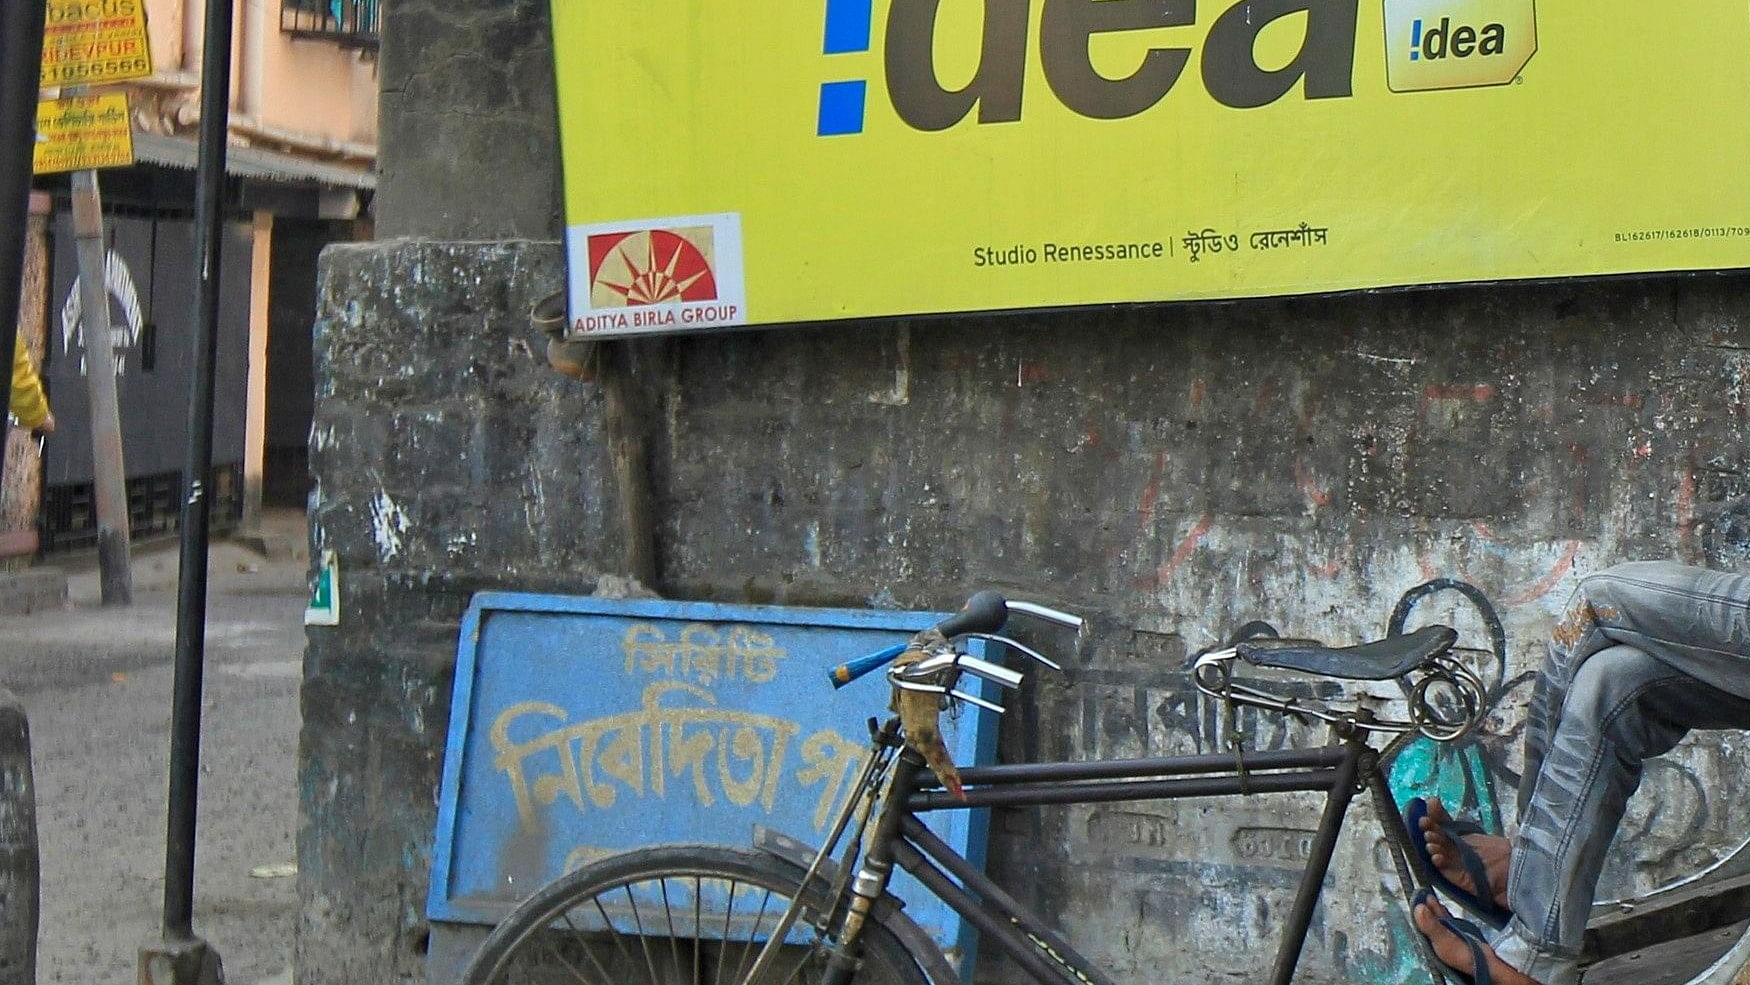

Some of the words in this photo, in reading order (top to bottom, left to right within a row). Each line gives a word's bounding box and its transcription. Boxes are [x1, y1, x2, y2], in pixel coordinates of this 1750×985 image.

[973, 245, 1037, 268] Studio
[1044, 240, 1164, 263] Renessance
[574, 313, 629, 333] ADITYA
[633, 310, 676, 328] BIRLA
[681, 305, 738, 324] GROUP
[489, 680, 799, 833] নিবেদিতা
